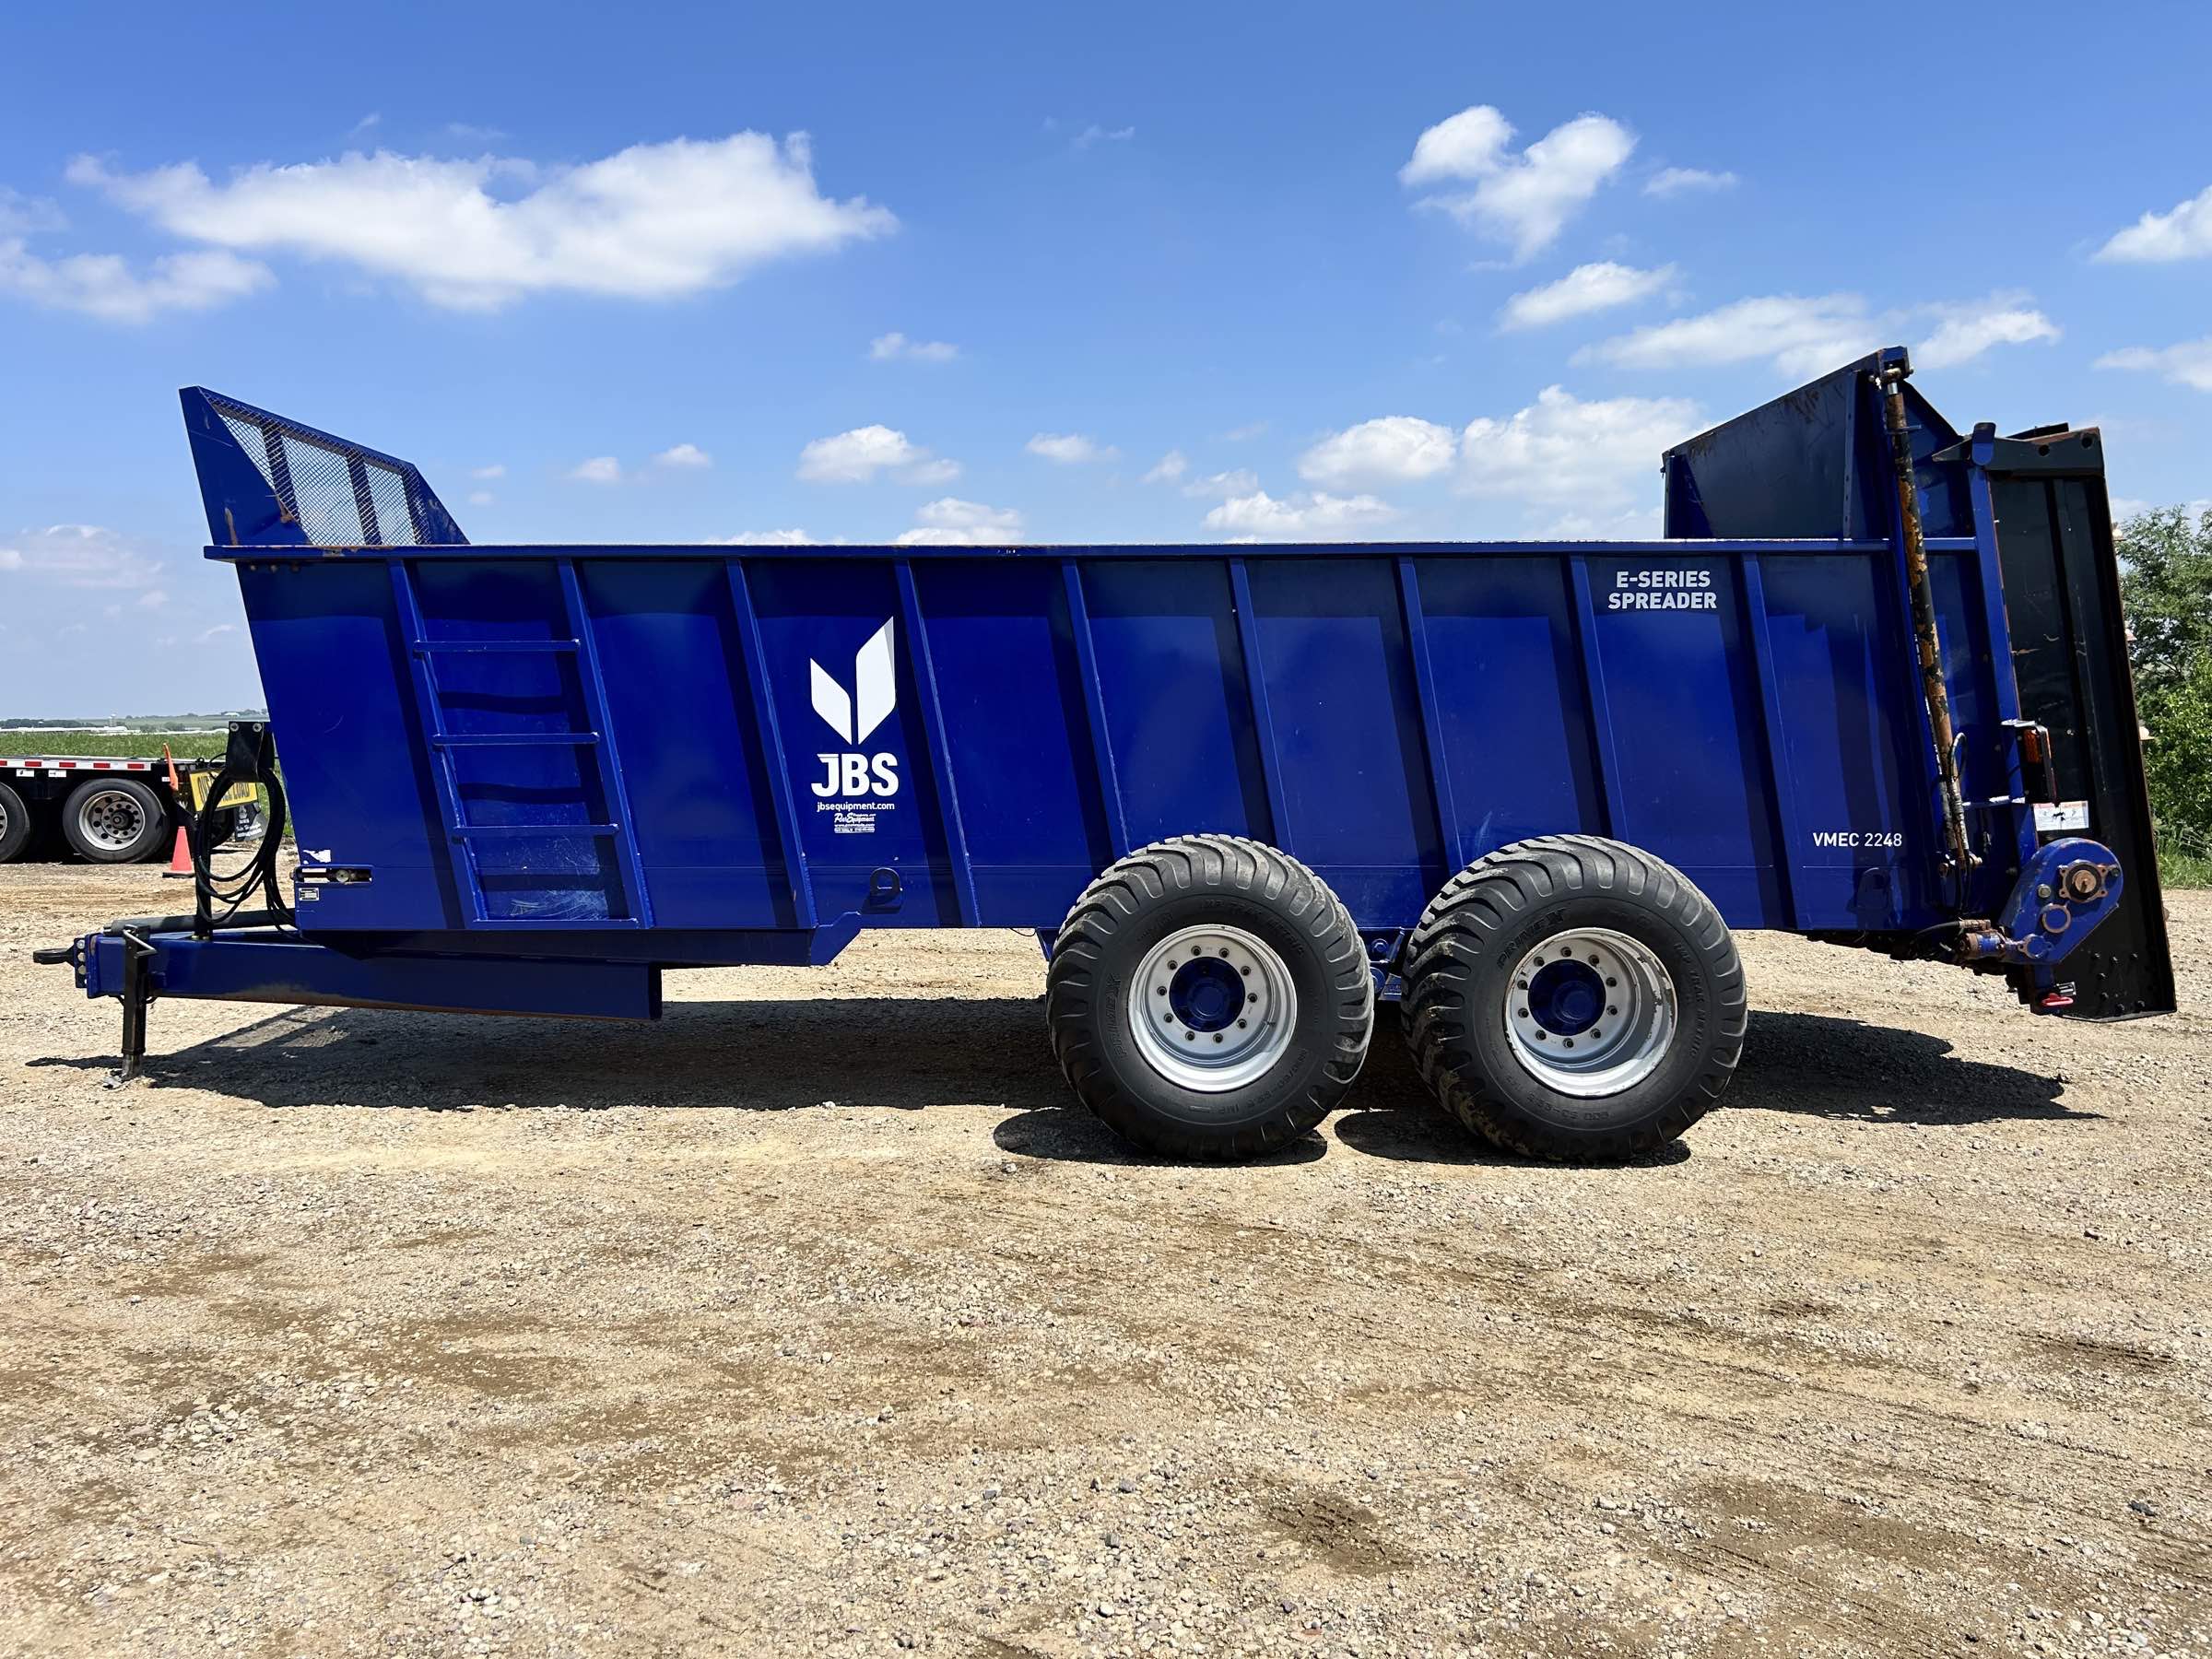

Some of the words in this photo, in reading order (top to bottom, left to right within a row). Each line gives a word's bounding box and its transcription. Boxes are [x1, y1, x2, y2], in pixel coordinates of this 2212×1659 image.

[1616, 571, 1711, 588] E-SERIES
[1607, 592, 1717, 609] SPREADER
[811, 752, 899, 797] JBS
[817, 801, 895, 812] jbsequipment.com
[1812, 832, 1860, 847] VMEC
[1864, 832, 1902, 847] 2248
